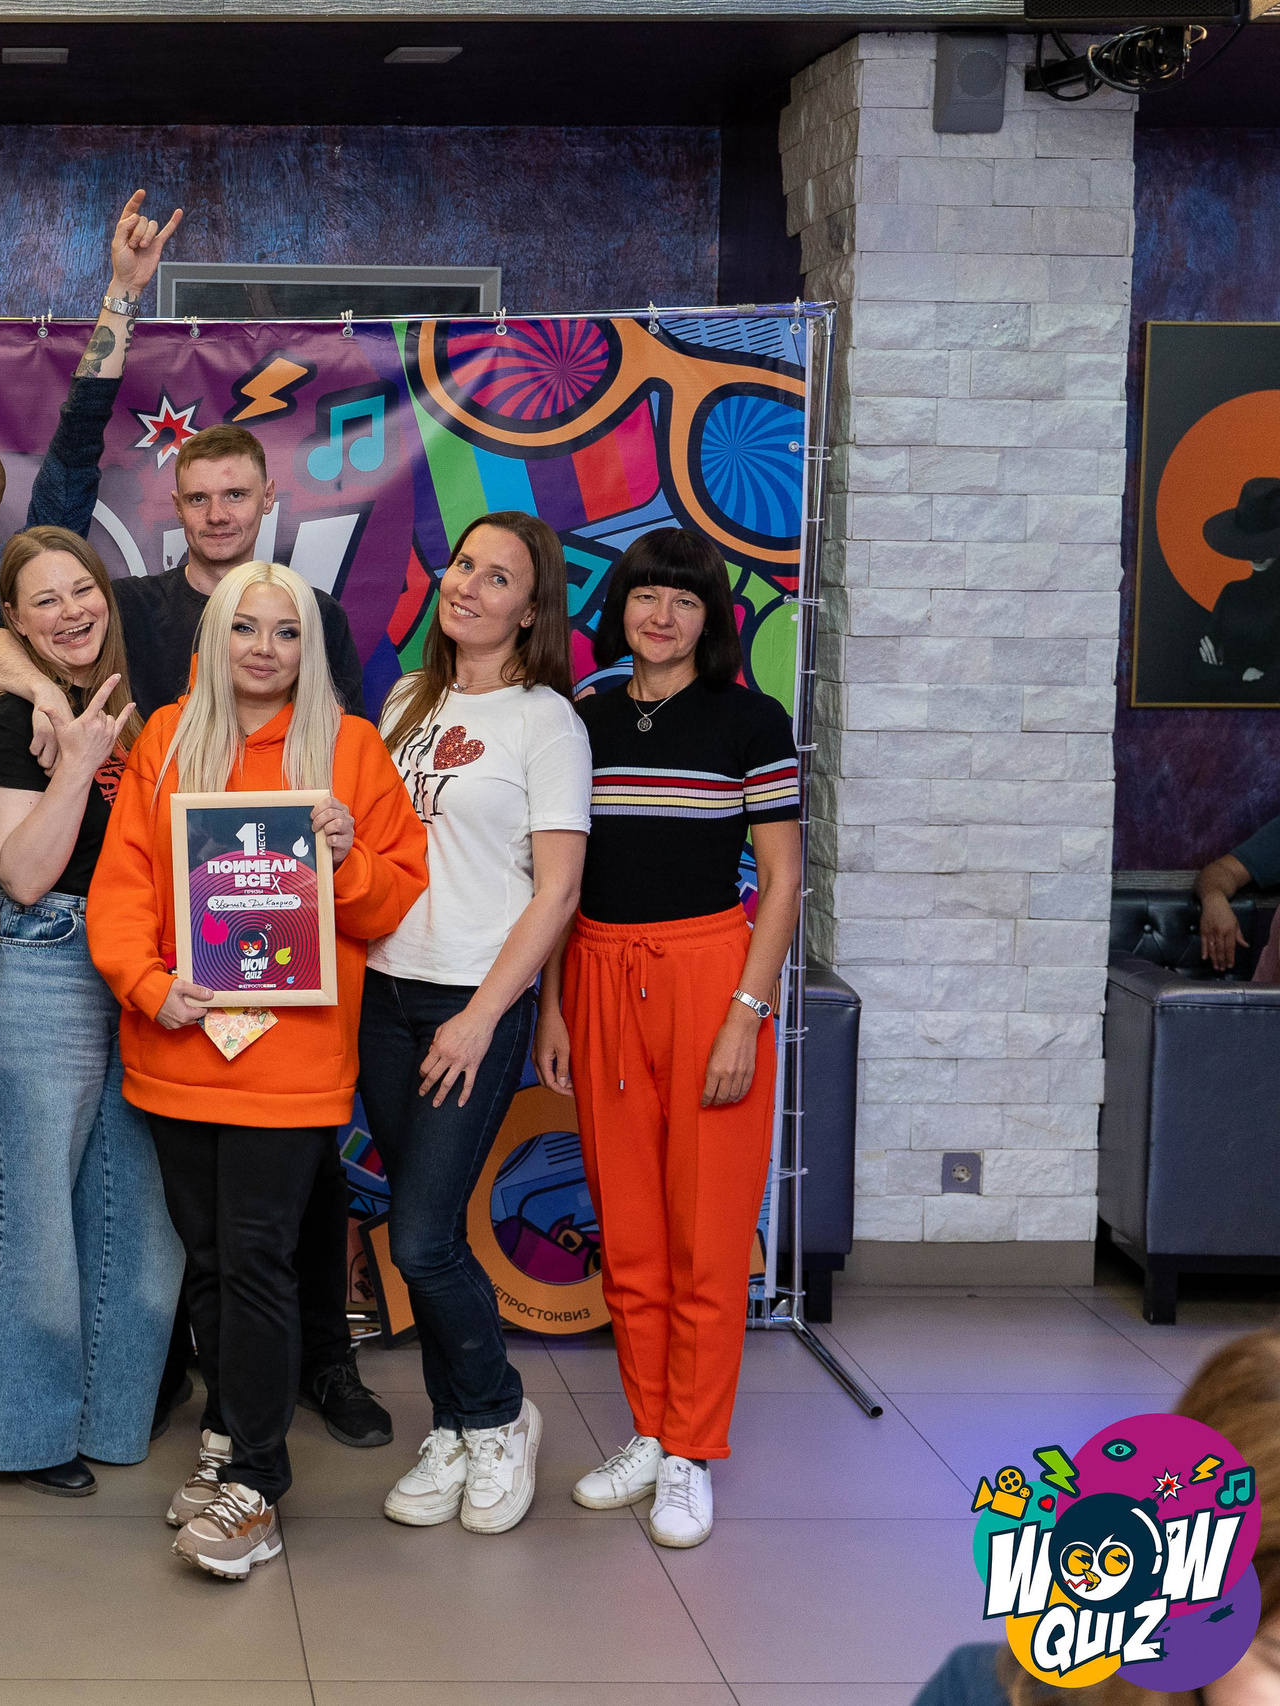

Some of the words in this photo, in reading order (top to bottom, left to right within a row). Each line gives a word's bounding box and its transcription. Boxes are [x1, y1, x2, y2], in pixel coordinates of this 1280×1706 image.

[235, 822, 258, 856] 1
[257, 822, 267, 856] МЕСТО
[207, 858, 297, 875] ПОИМЕЛИ
[240, 956, 269, 972] WOW
[244, 971, 263, 980] QUIZ
